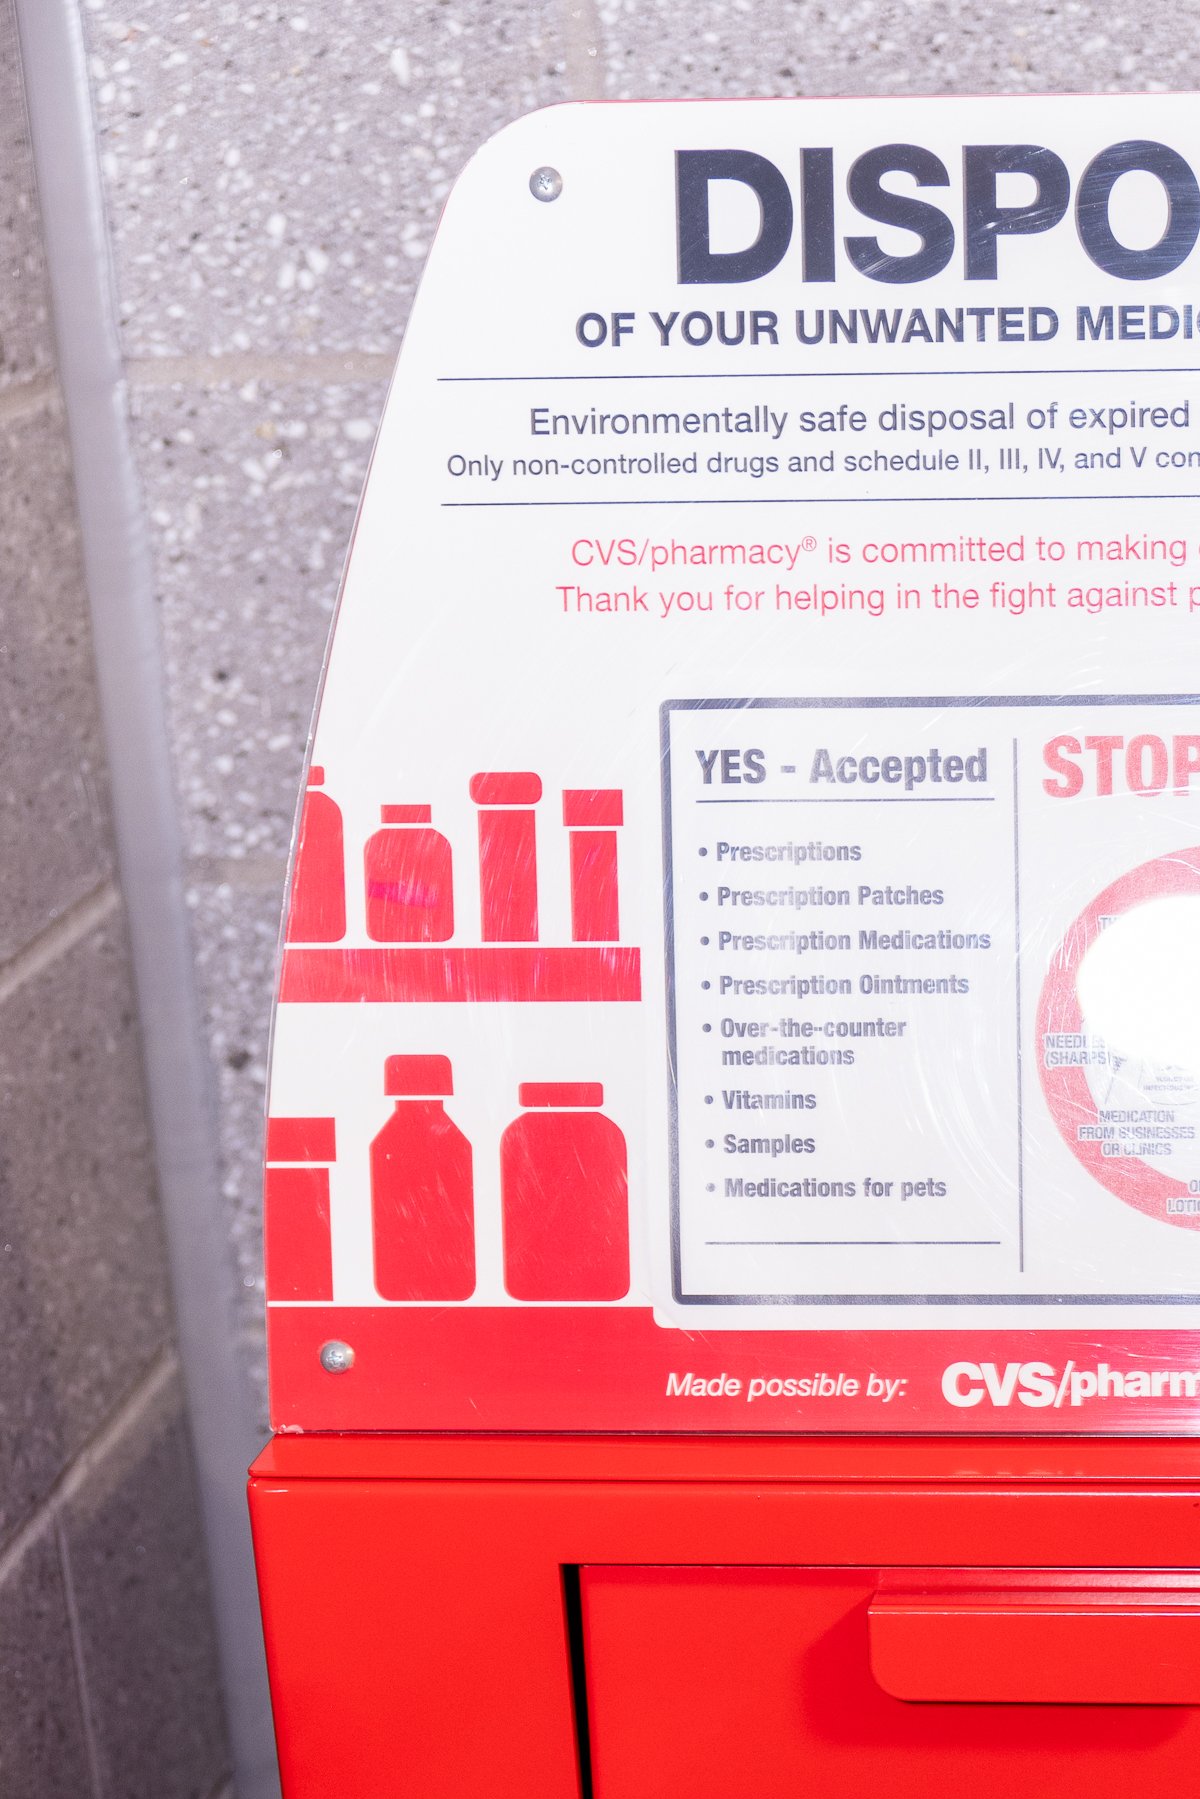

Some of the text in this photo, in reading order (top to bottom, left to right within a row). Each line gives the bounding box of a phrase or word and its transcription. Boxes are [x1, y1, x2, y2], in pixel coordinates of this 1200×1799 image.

[576, 312, 635, 347] OF
[649, 311, 779, 346] YOUR
[796, 307, 1058, 344] UNWANTED
[531, 405, 788, 439] Environmentally
[800, 405, 866, 432] safe
[879, 403, 1013, 437] disposal
[1027, 402, 1058, 429] of
[1069, 400, 1189, 435] expired
[448, 455, 503, 481] Only
[513, 452, 697, 475] non-controlled
[707, 452, 779, 478] drugs
[788, 451, 834, 472] and
[845, 449, 959, 471] schedule
[969, 449, 989, 473] II,
[1000, 448, 1027, 473] III,
[1039, 448, 1064, 472] IV,
[1075, 447, 1120, 469] and
[1130, 447, 1147, 467] V
[829, 538, 851, 563] is
[863, 536, 1024, 563] committed
[1036, 537, 1065, 561] to
[1078, 534, 1186, 566] making
[556, 586, 648, 612] Thank
[659, 592, 712, 618] you
[724, 585, 765, 610] for
[776, 584, 884, 616] helping
[898, 583, 920, 608] in
[932, 583, 979, 608] the
[990, 582, 1056, 615] fight
[1068, 581, 1177, 614] against
[695, 749, 766, 784] YES
[810, 748, 987, 790] Accepted
[717, 841, 862, 865] Prescriptions
[717, 885, 944, 910] Prescription Patches
[719, 930, 991, 955] Prescription Medications
[720, 974, 969, 999] Prescription Ointments
[721, 1018, 907, 1038] Over-the-counter
[722, 1046, 854, 1066] medications
[722, 1090, 816, 1110] Vitamins
[1099, 1110, 1175, 1123] MEDICATION
[1079, 1126, 1115, 1140] FROM
[724, 1134, 815, 1158] Samples
[1102, 1142, 1121, 1156] OR
[725, 1177, 946, 1201] Medications for pets
[666, 1373, 908, 1402] Made possible by:
